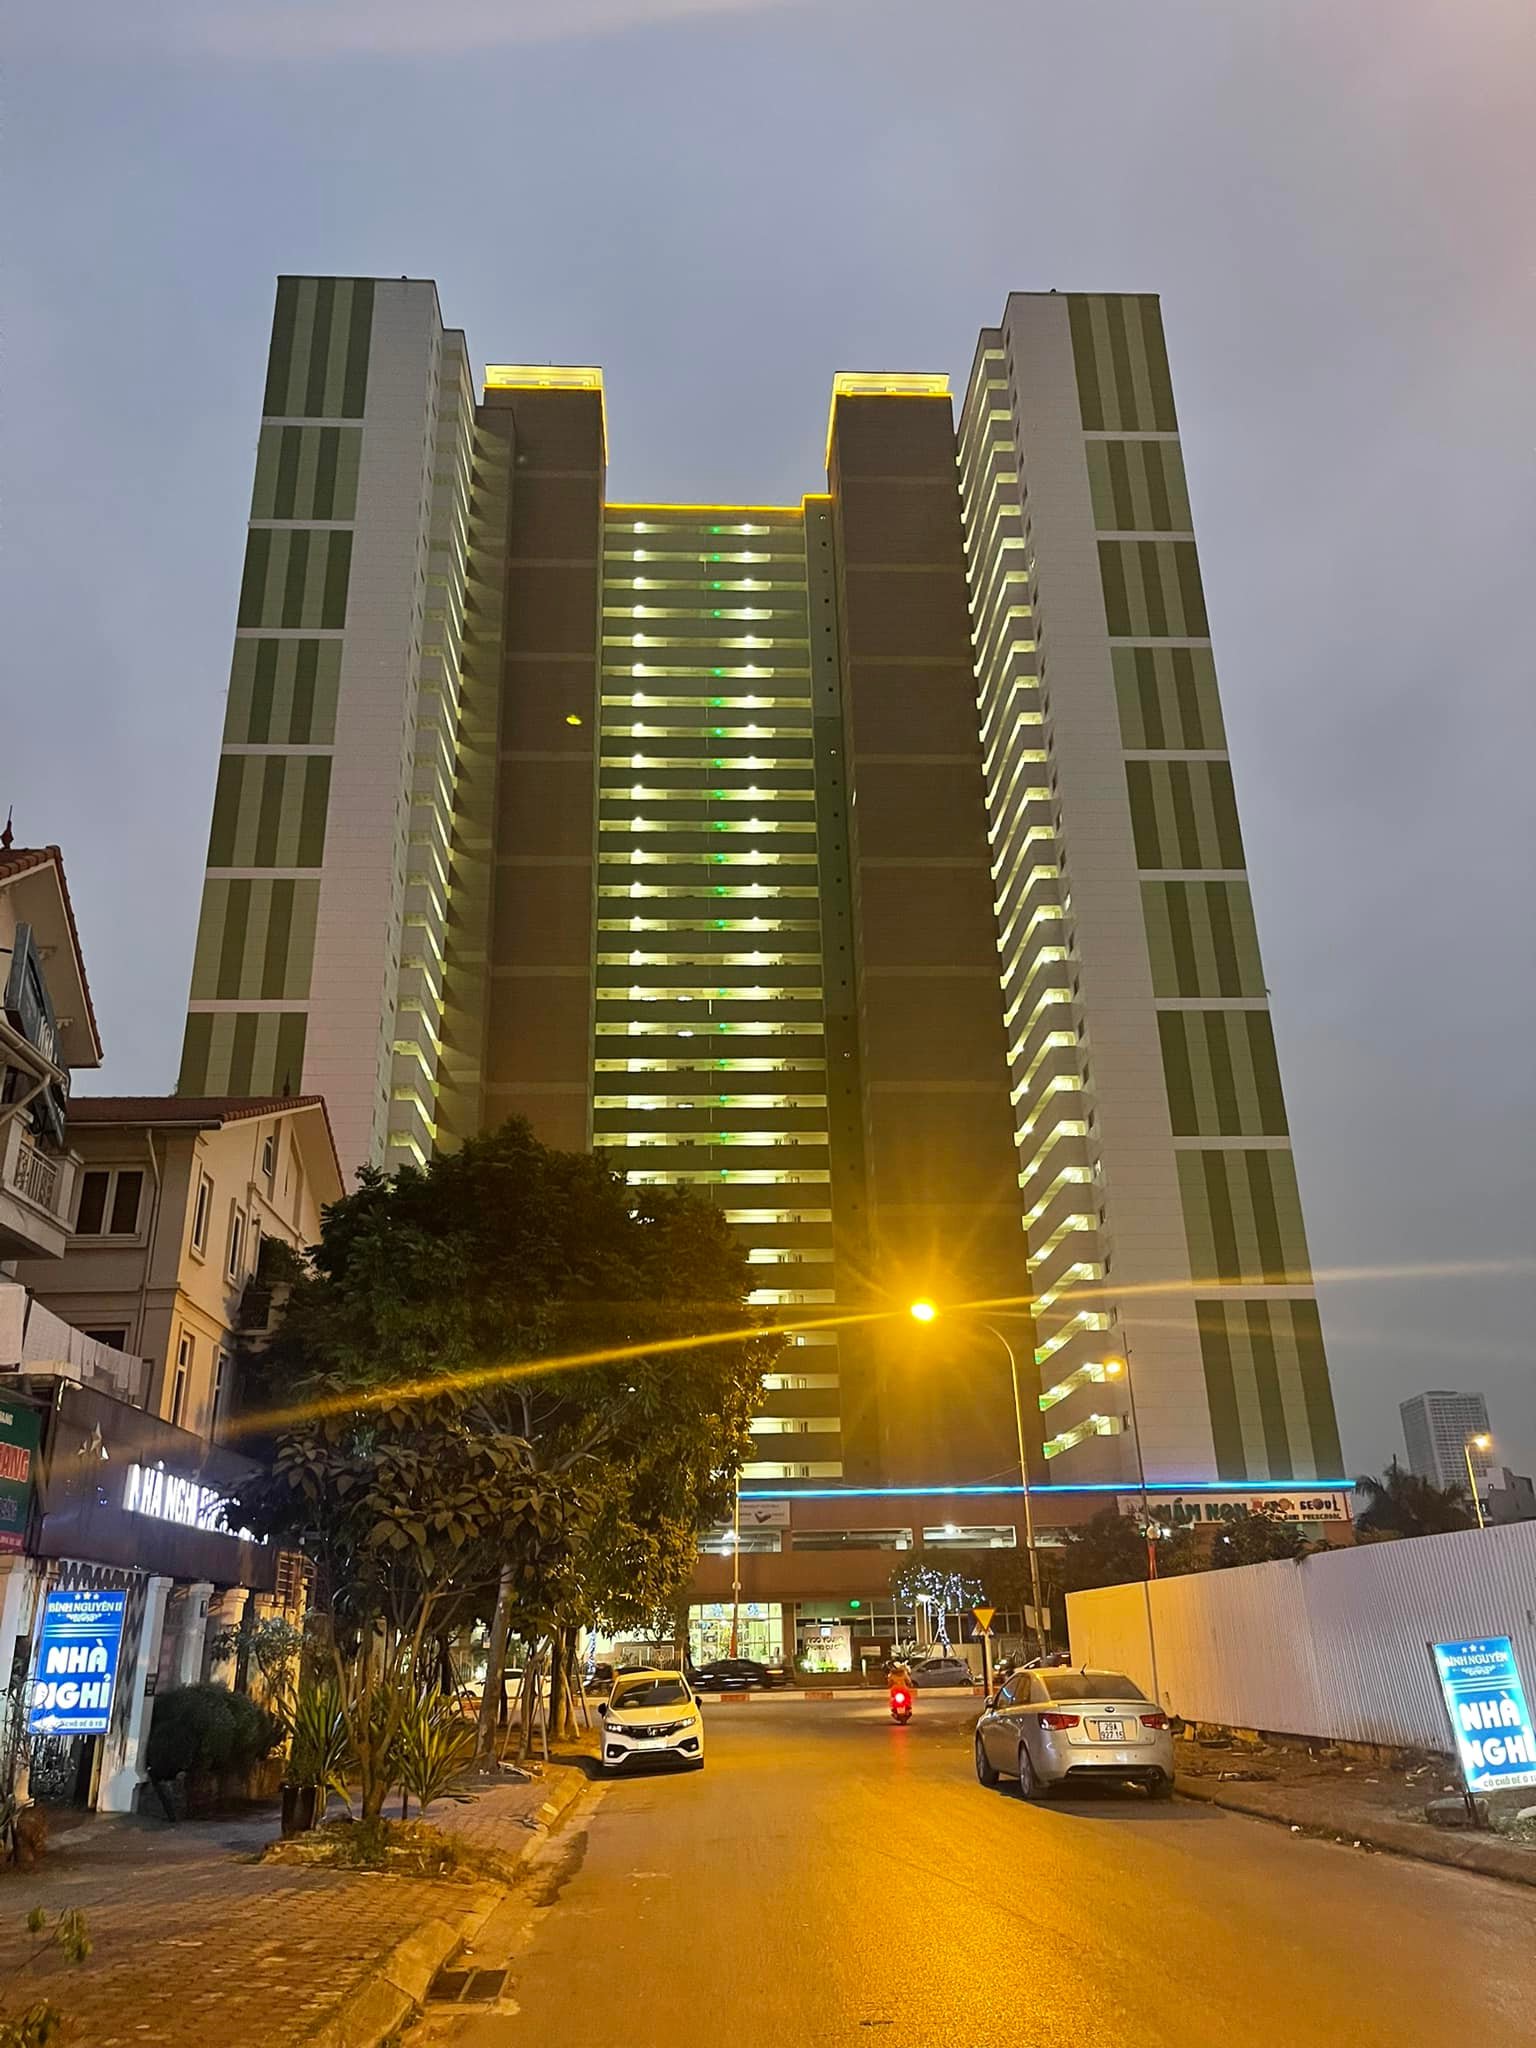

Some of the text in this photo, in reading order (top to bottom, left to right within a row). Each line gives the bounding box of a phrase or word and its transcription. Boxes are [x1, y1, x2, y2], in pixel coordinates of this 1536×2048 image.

[46, 1638, 108, 1674] NHÀ
[34, 1673, 111, 1709] NGHỈ
[1459, 1690, 1521, 1731] NHÀ
